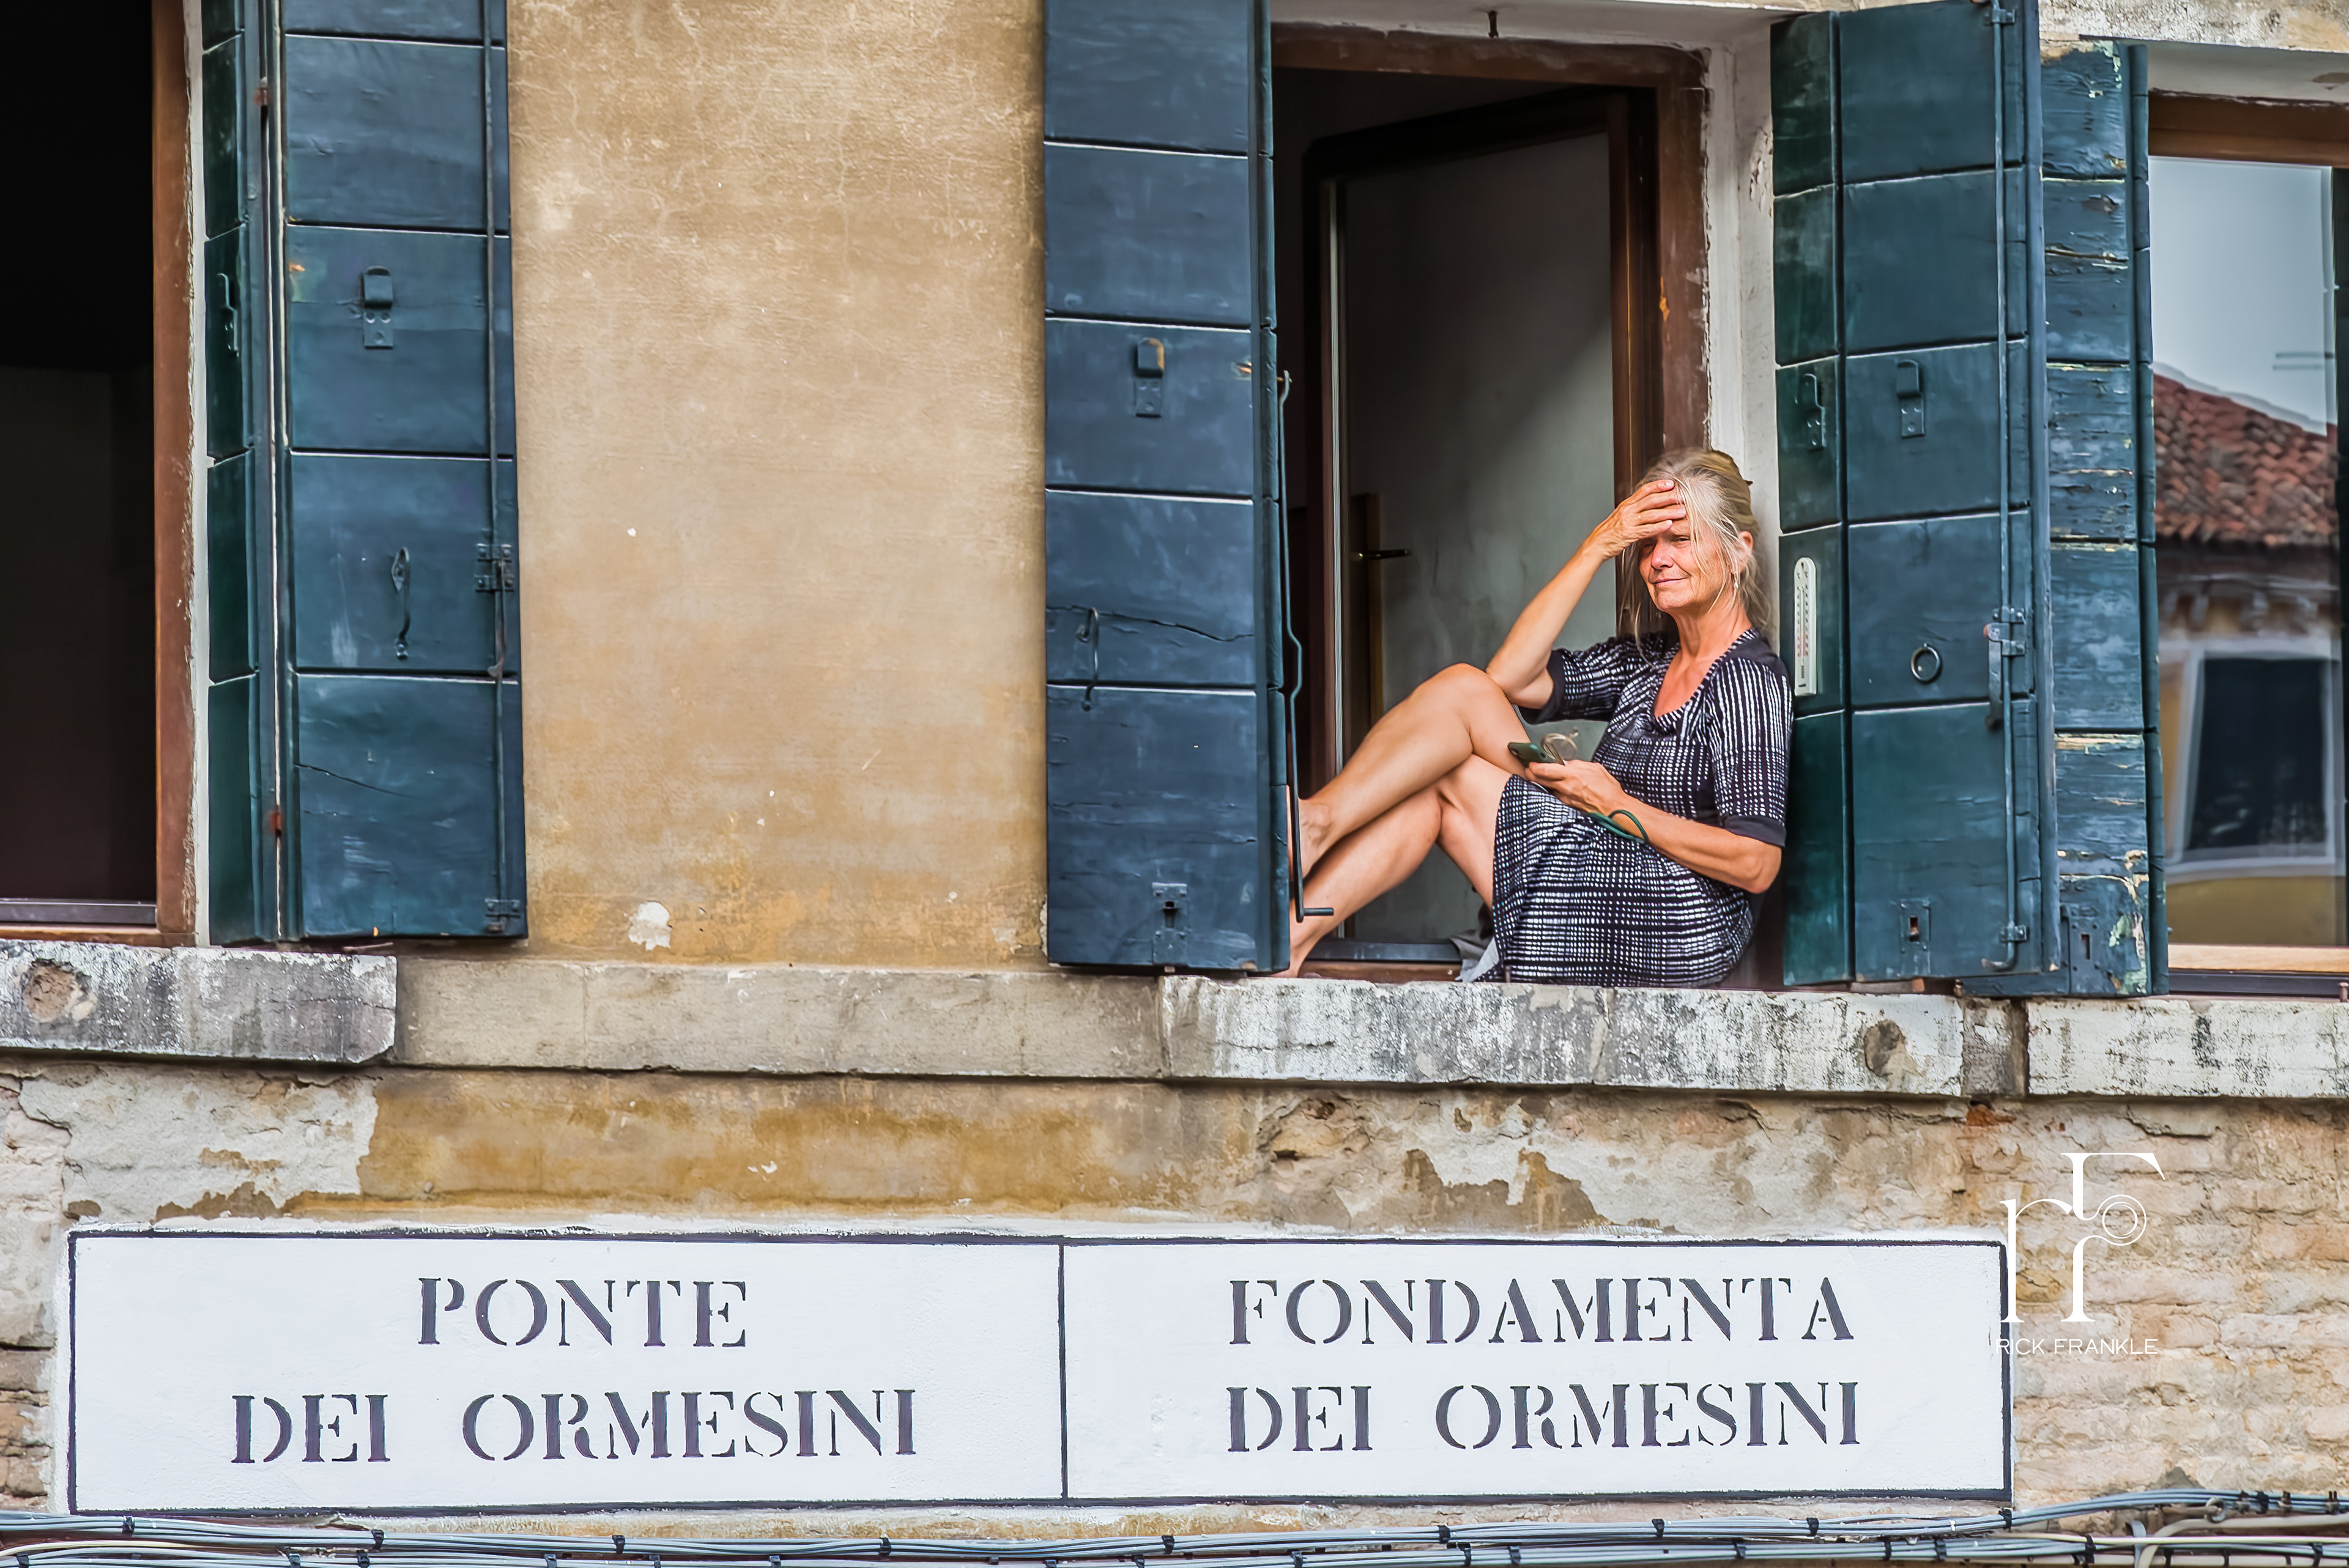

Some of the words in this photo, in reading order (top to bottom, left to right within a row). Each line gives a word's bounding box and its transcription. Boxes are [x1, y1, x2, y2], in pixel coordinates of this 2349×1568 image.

[418, 1278, 746, 1347] PONTE
[1230, 1277, 1854, 1344] FONDAMENTA
[231, 1394, 390, 1463] DEI
[463, 1389, 916, 1461] ORMESINI
[1226, 1386, 1373, 1452] DEI
[1436, 1382, 1860, 1449] ORMESINI
